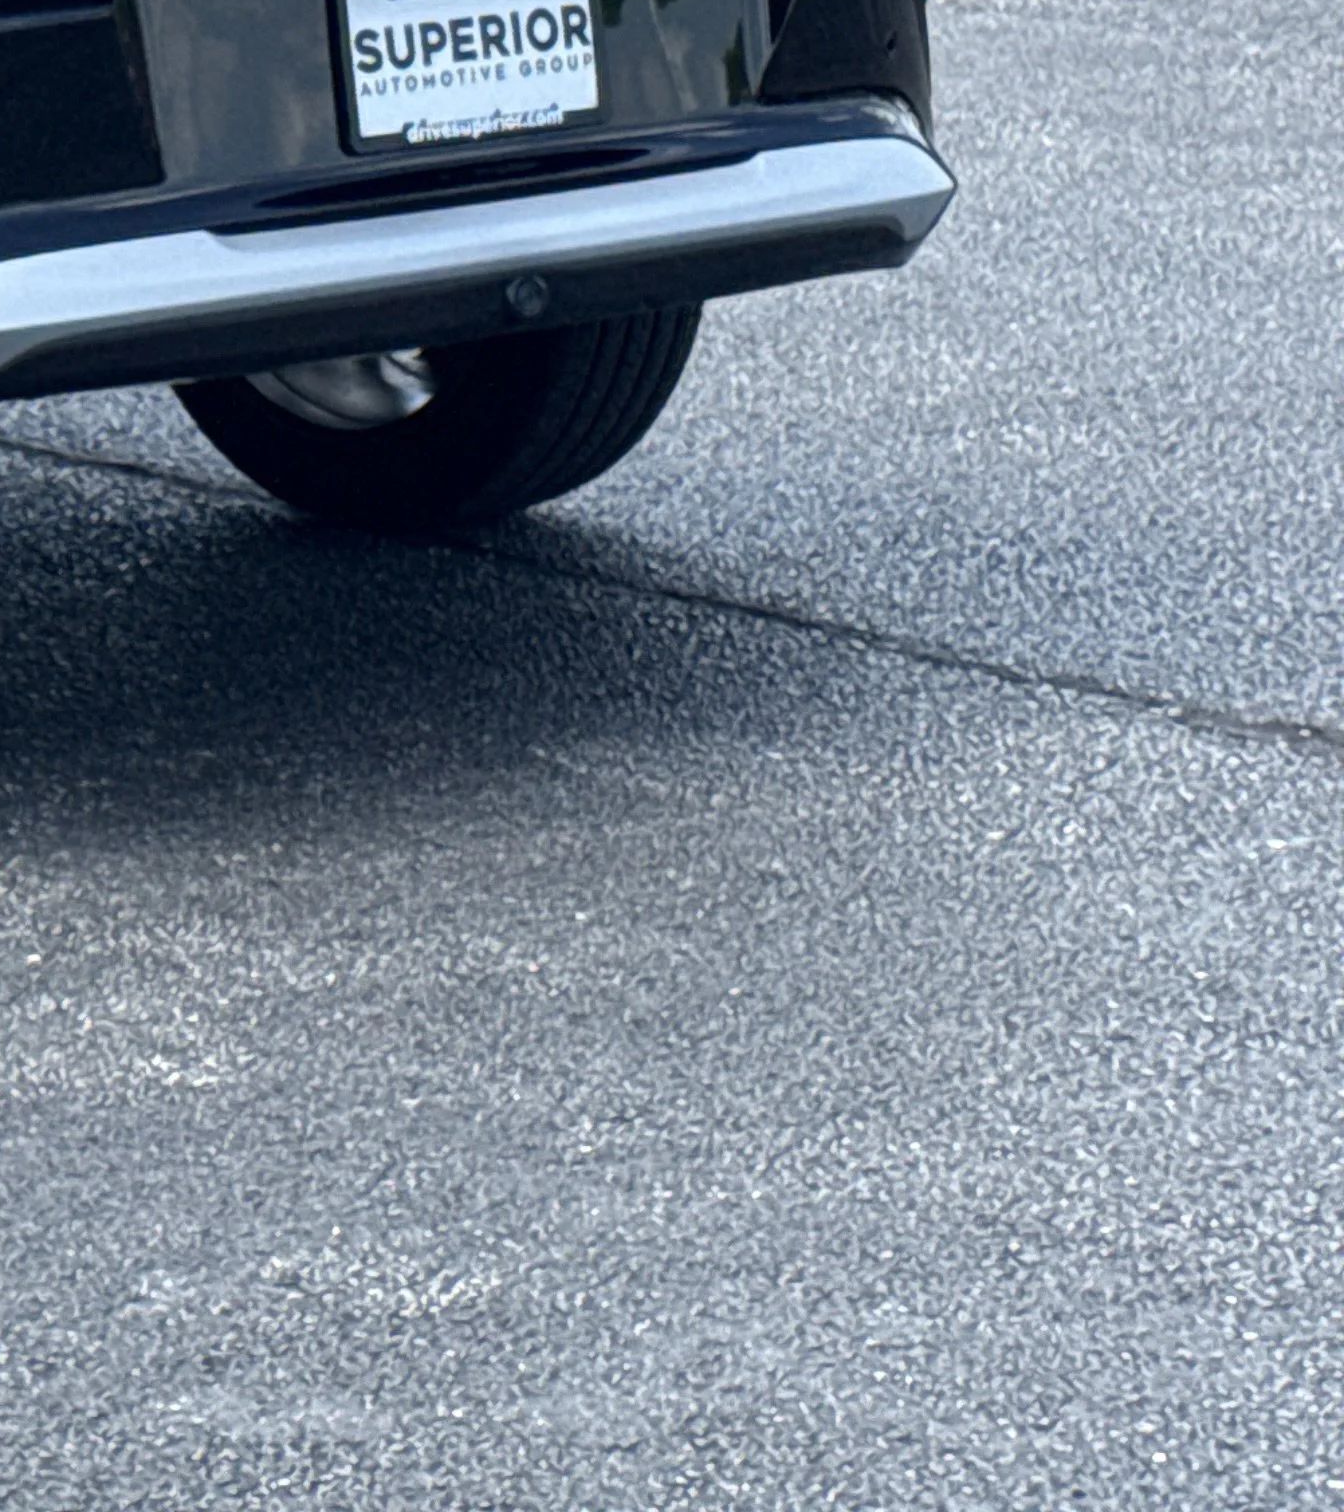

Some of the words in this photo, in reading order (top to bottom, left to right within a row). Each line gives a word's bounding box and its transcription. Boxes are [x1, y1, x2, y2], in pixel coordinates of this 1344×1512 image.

[353, 4, 591, 74] SUPERIOR
[360, 63, 507, 98] AUTOMOTIVE
[518, 53, 594, 78] GROUP
